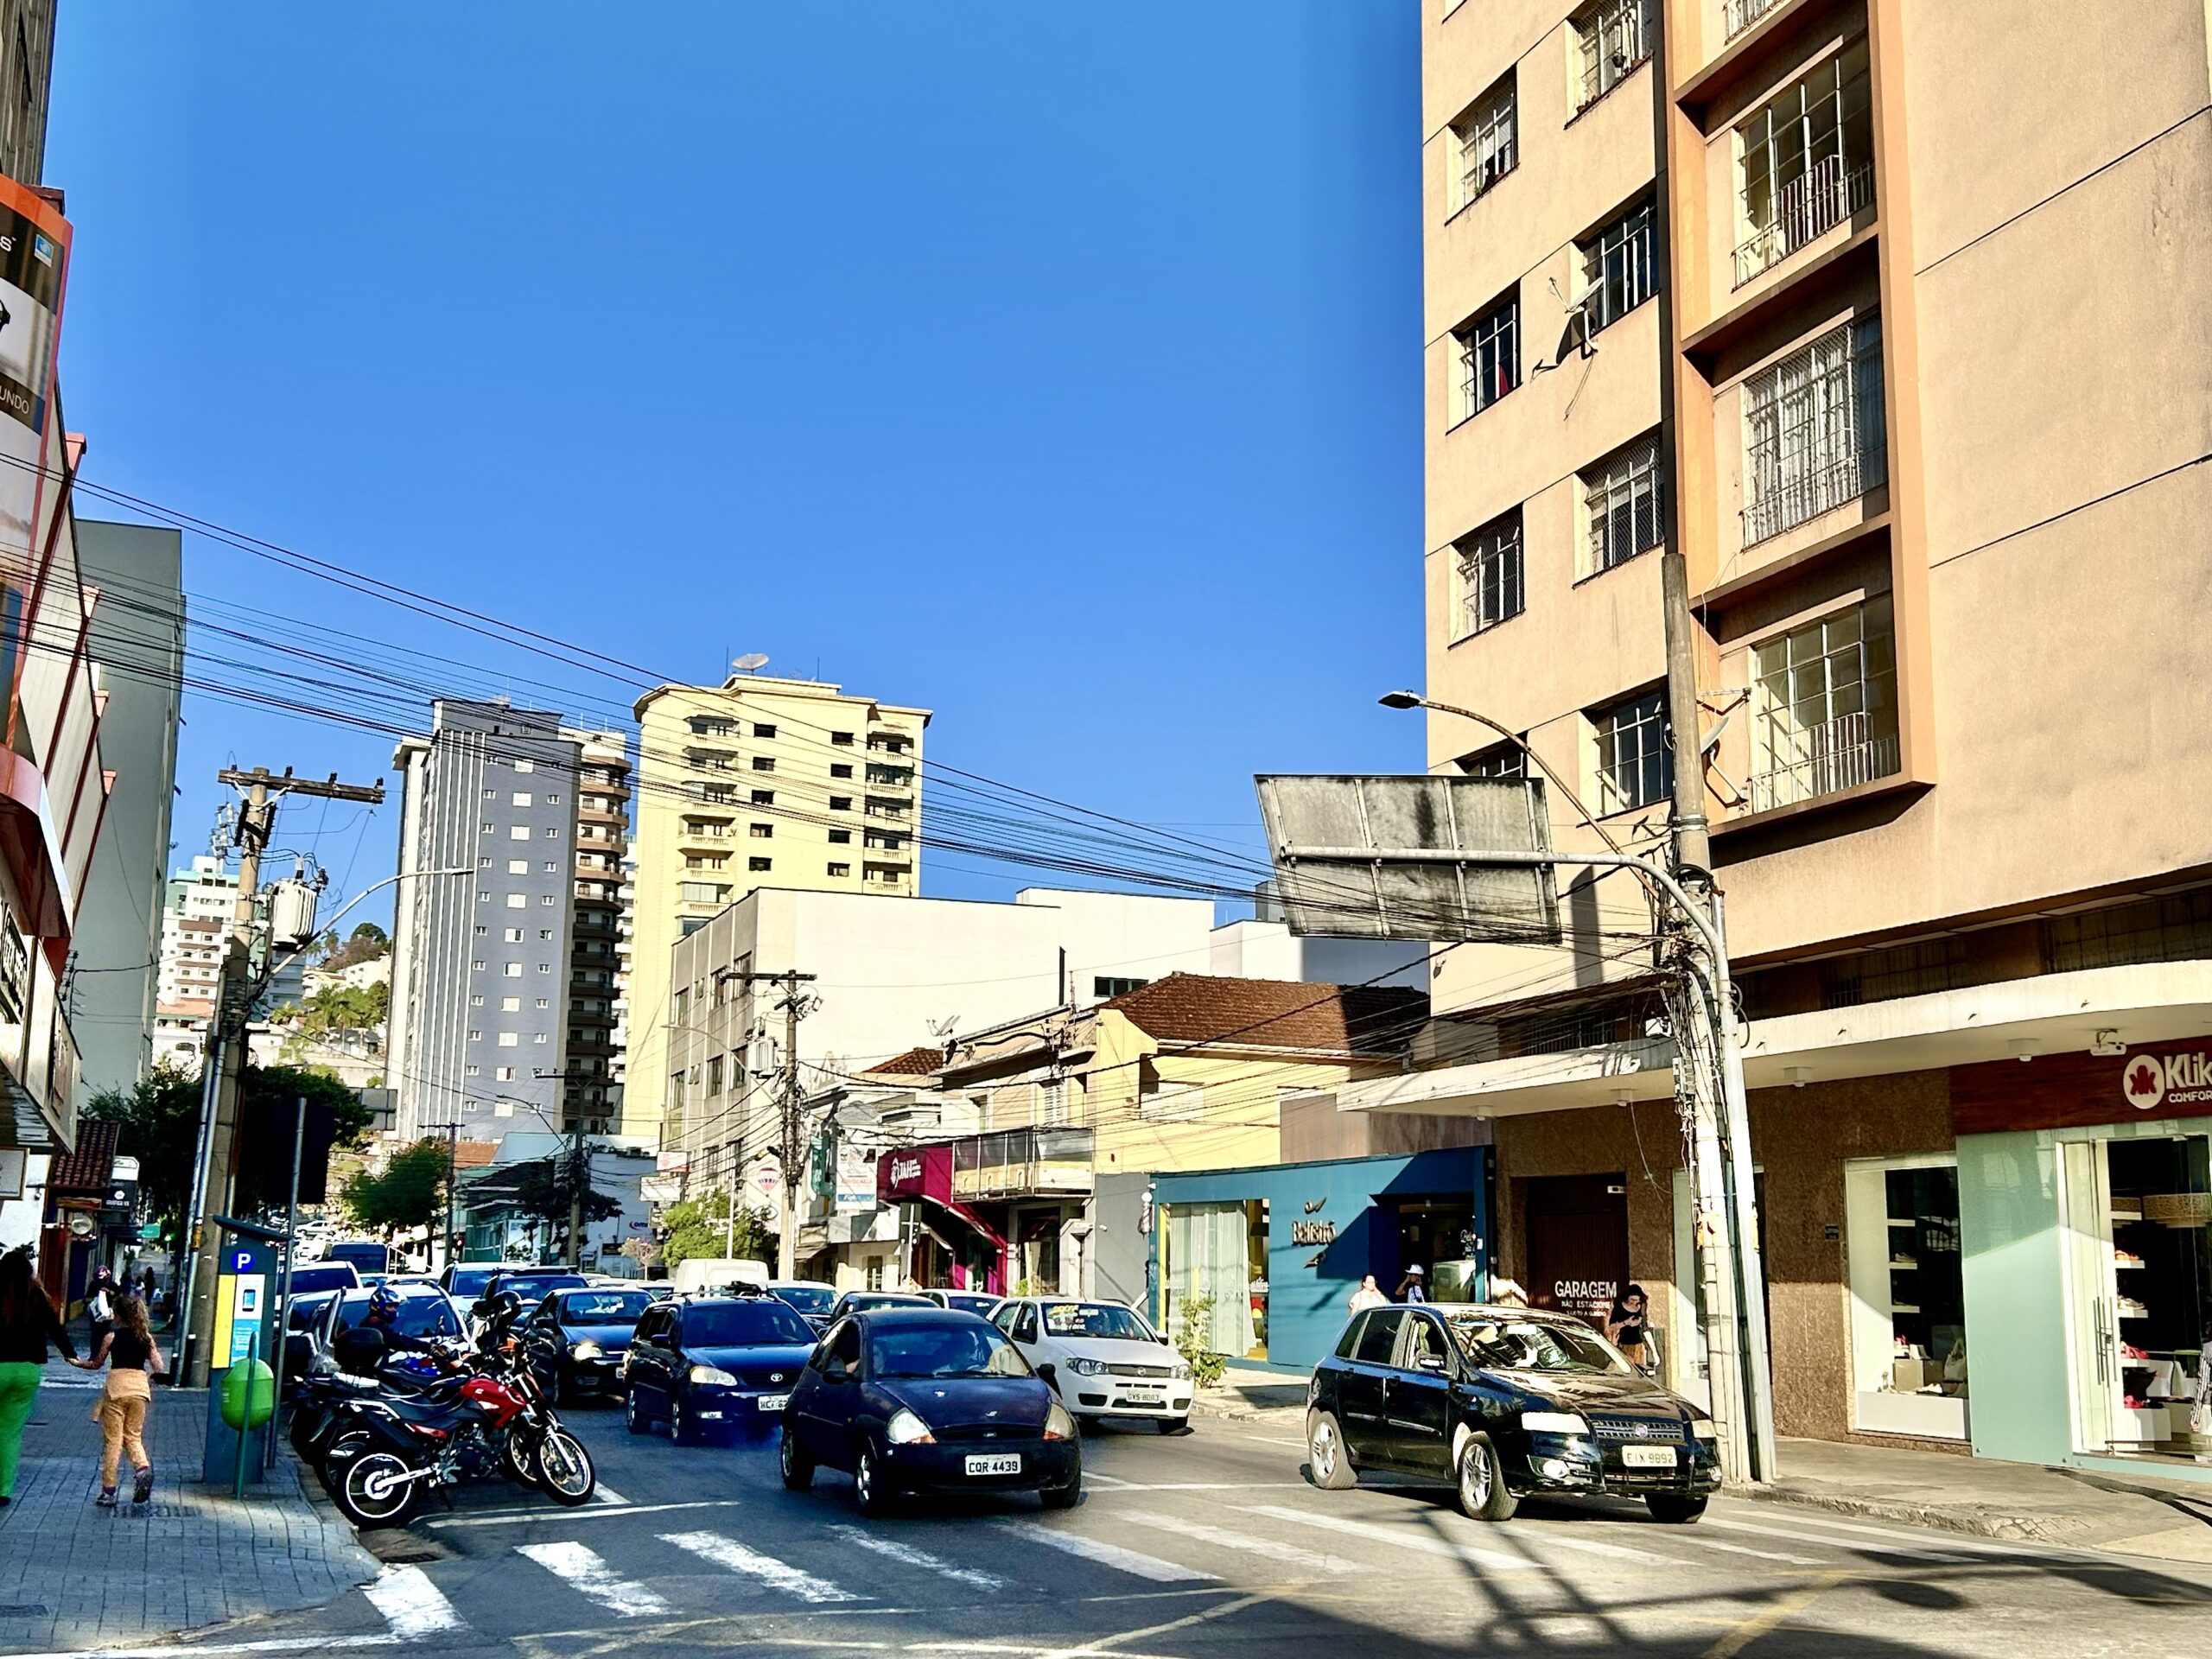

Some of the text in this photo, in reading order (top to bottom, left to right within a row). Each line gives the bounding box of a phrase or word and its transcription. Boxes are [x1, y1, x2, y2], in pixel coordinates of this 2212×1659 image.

[237, 1253, 251, 1269] P
[1554, 1280, 1618, 1299] GARAGEM
[992, 1460, 1018, 1472] 4439
